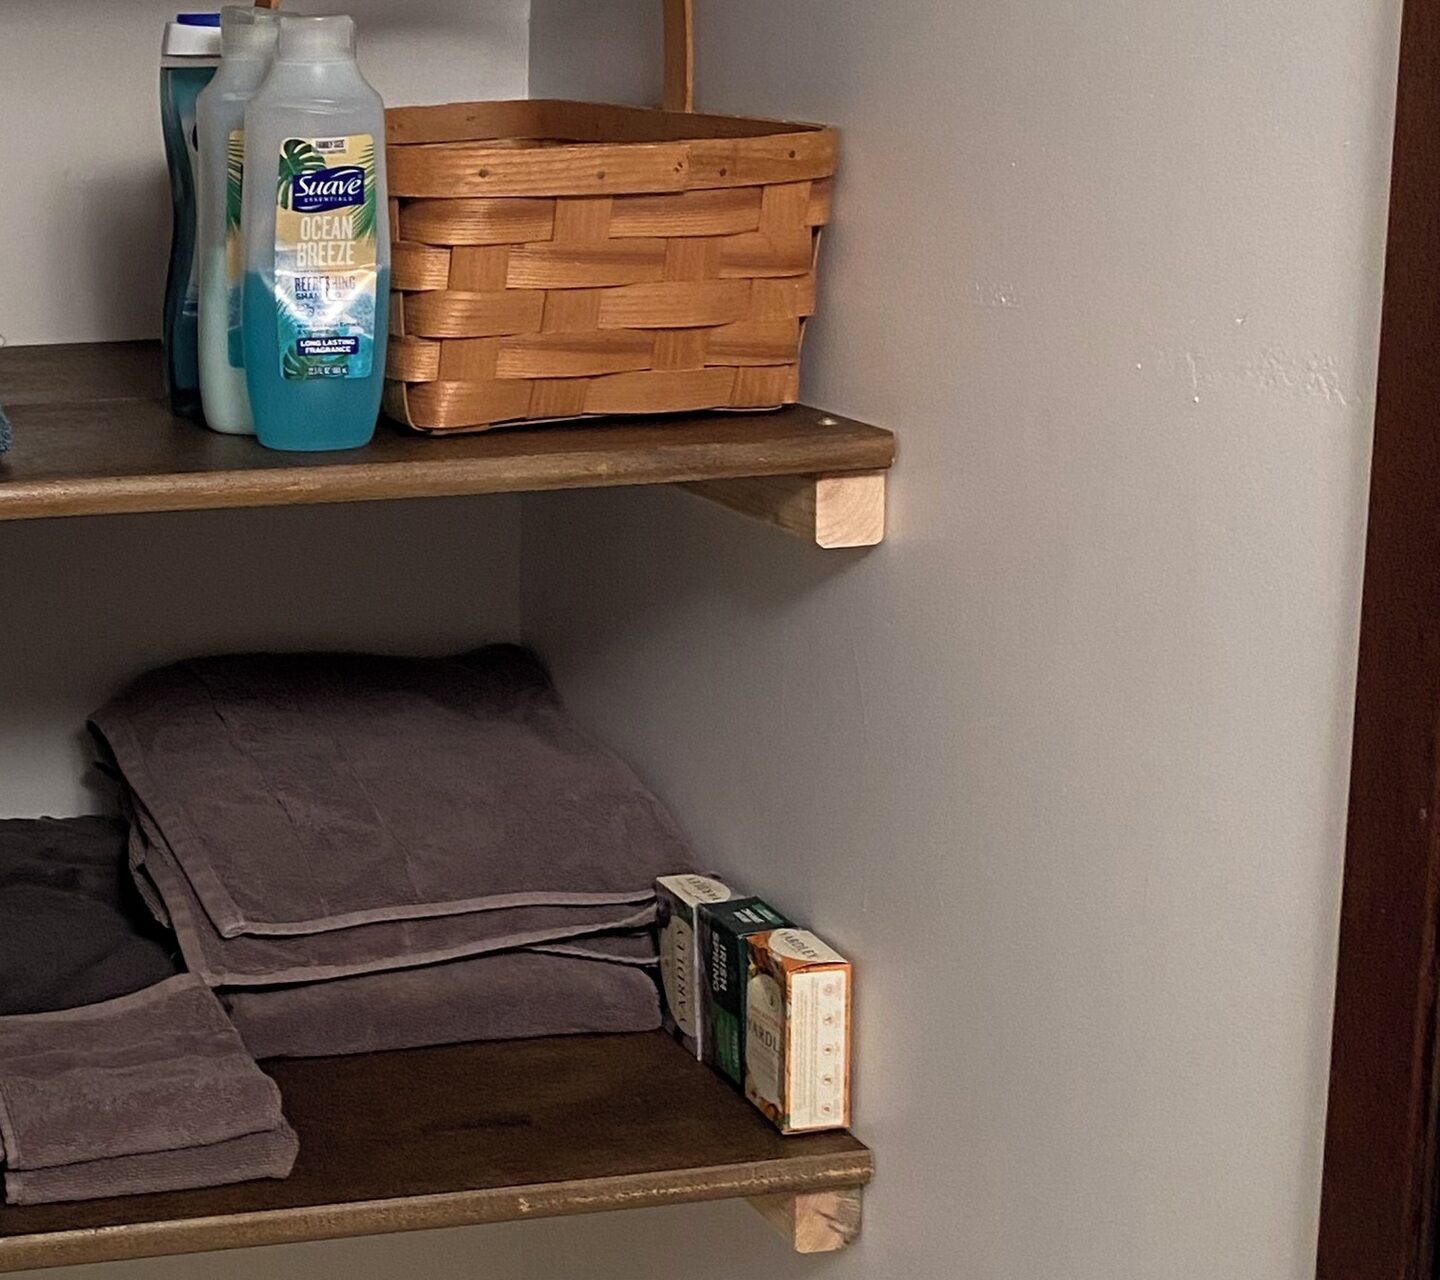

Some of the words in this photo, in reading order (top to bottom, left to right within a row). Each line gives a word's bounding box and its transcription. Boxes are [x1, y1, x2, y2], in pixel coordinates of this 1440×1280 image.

[295, 175, 362, 197] Suave
[300, 215, 353, 241] OCEAN
[296, 240, 356, 268] BREEZE
[300, 339, 322, 348] LONG
[323, 339, 356, 347] LASTING
[304, 345, 352, 354] FRAGRANCE
[712, 930, 720, 993] SPRING
[719, 943, 728, 992] IRISH
